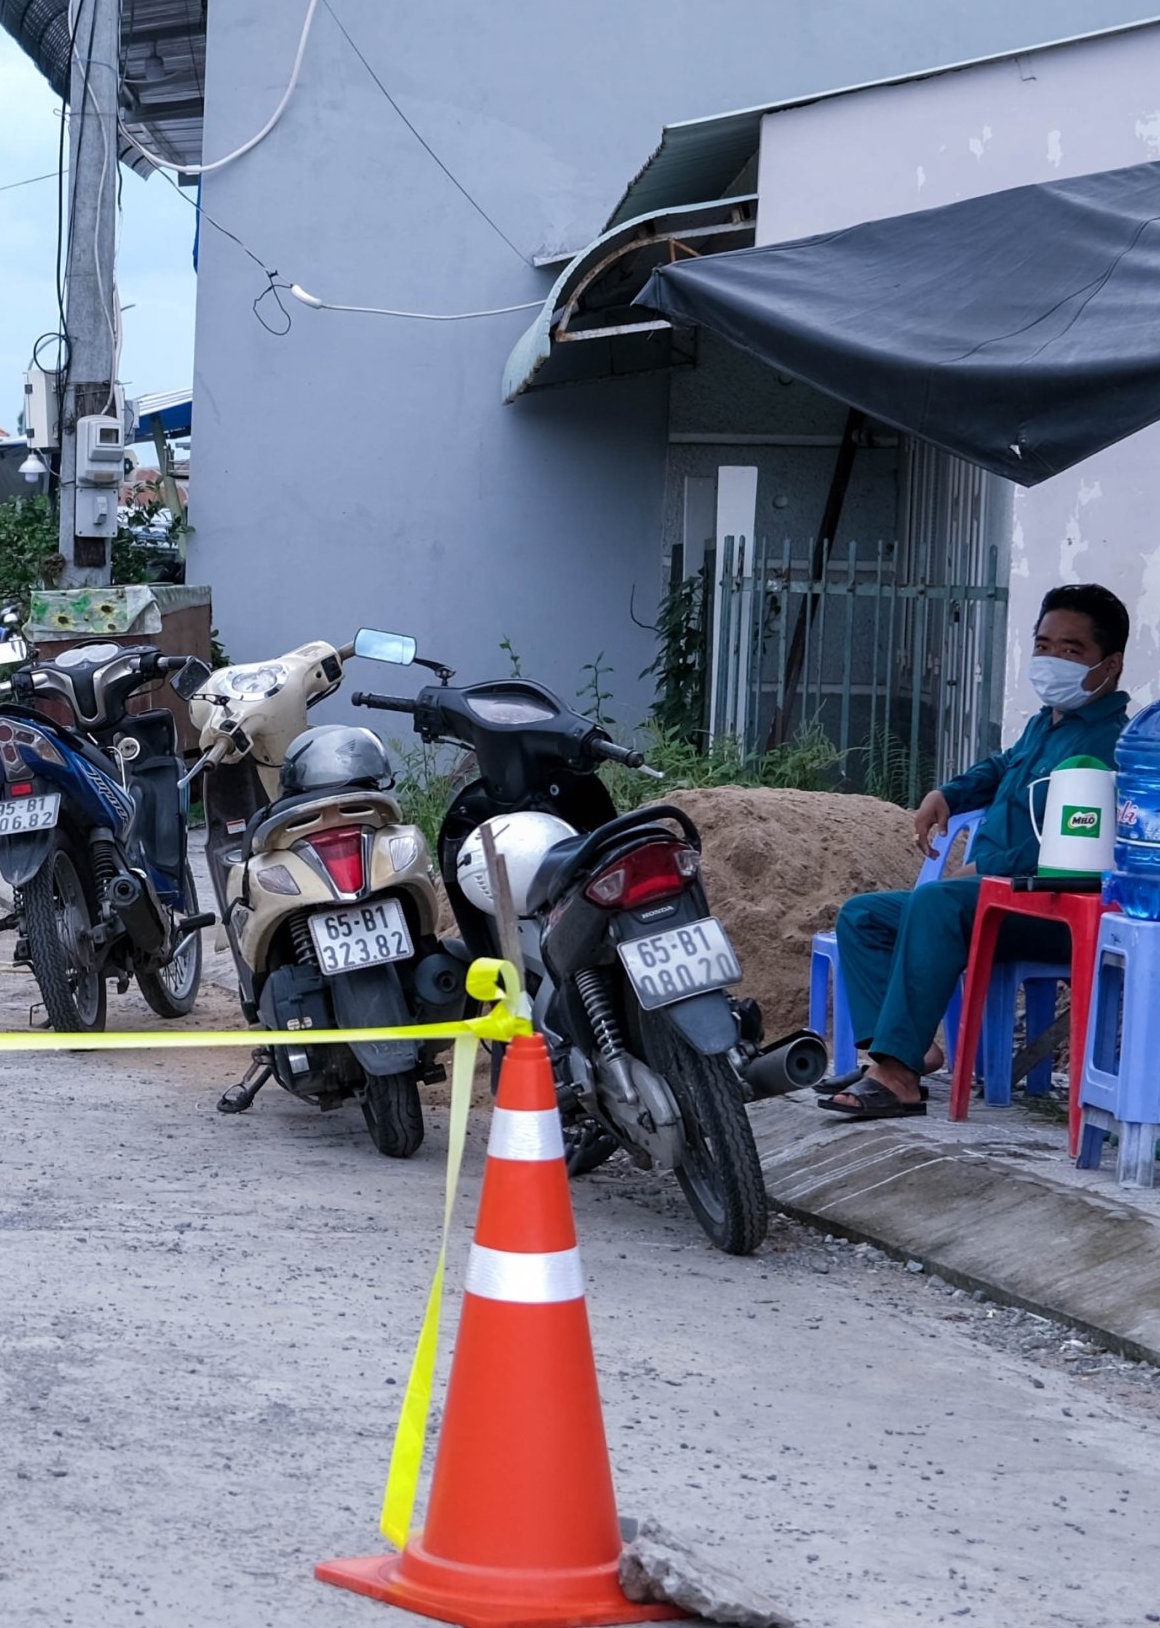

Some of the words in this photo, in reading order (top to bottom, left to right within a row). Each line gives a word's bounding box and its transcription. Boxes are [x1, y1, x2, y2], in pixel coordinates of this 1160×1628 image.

[1071, 816, 1095, 825] MILO
[324, 905, 389, 940] 65-B1
[641, 905, 674, 919] HONDA
[323, 930, 408, 969] 323.82
[636, 925, 711, 968] 65-B1
[640, 952, 736, 996] 080.20
